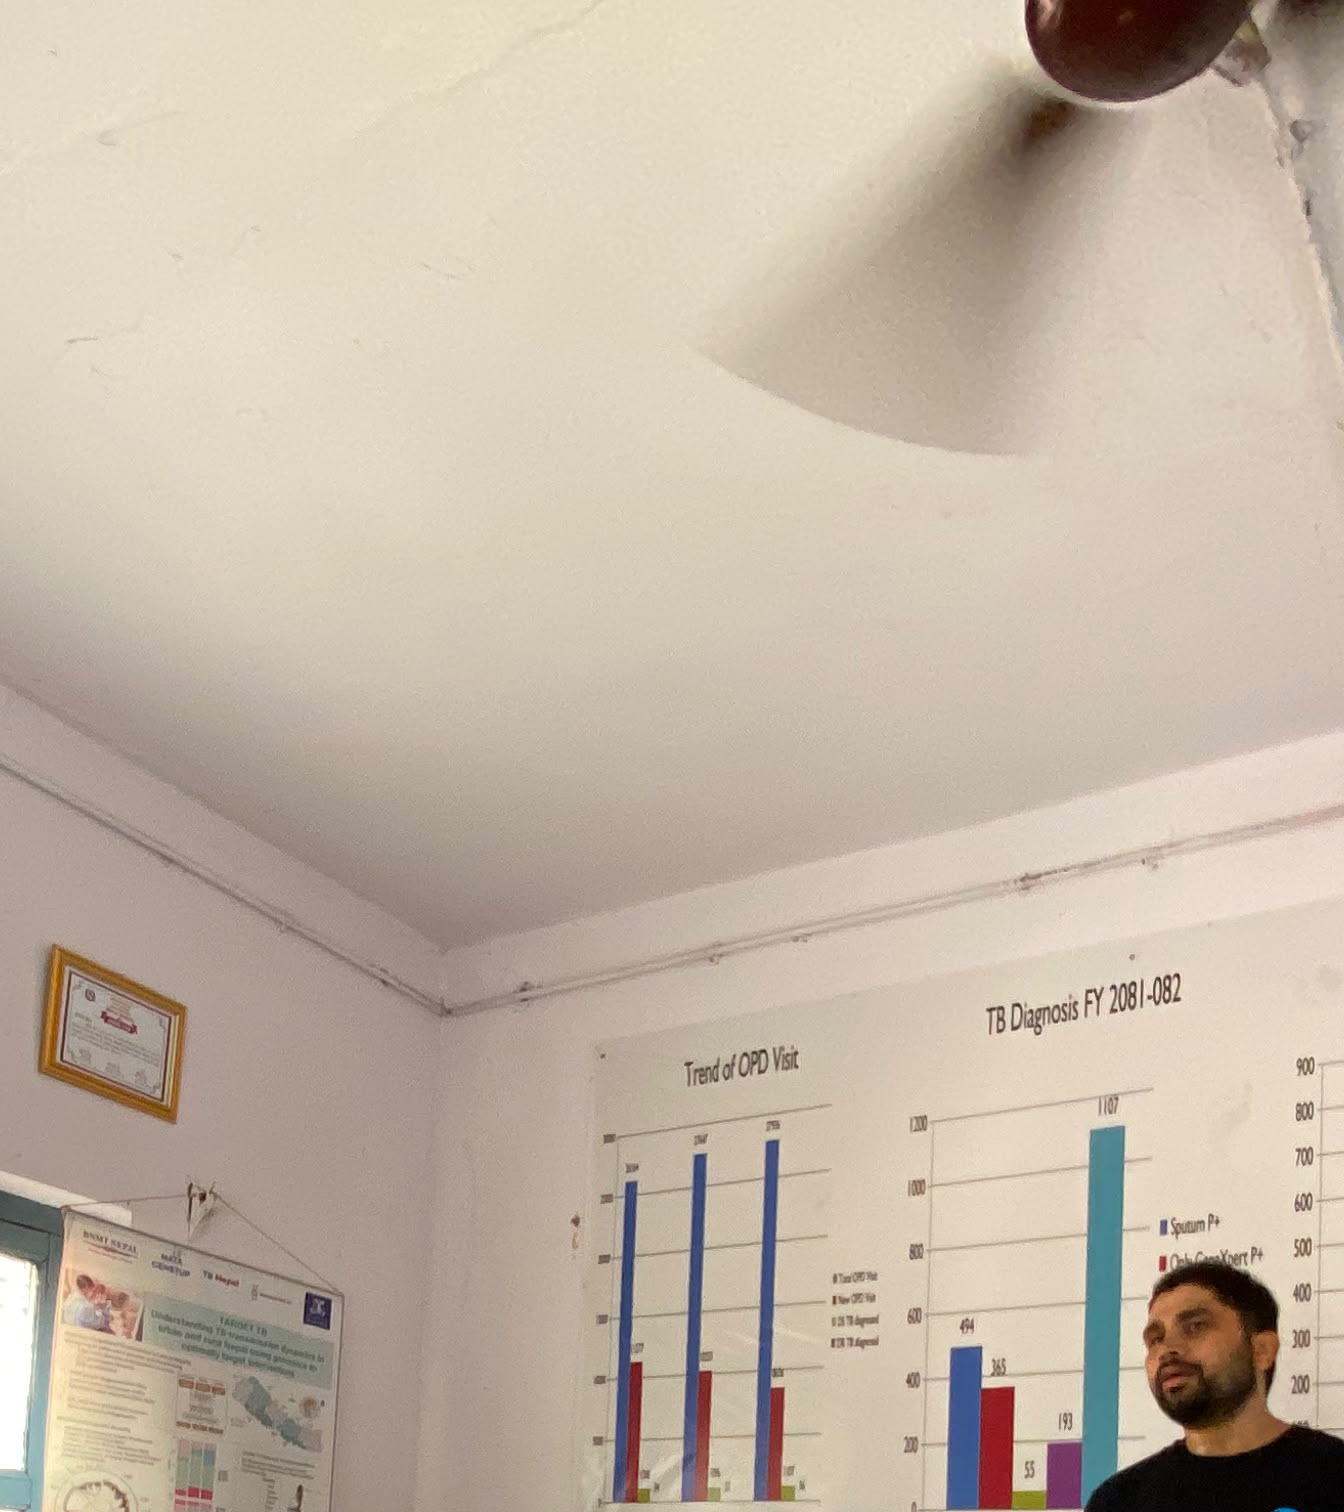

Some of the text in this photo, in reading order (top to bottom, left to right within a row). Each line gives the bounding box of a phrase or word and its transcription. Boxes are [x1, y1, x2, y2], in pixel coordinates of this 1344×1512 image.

[986, 972, 1183, 1036] TB Diagnosis FY 2081-082
[684, 1044, 800, 1087] Trend of OPD Visit
[1296, 1056, 1316, 1076] 900
[1097, 1096, 1120, 1117] 1107
[1295, 1102, 1315, 1122] 800
[909, 1115, 928, 1133] 1200
[1295, 1147, 1315, 1167] 700
[907, 1179, 927, 1197] 1000
[1294, 1192, 1313, 1213] 600
[1171, 1213, 1221, 1240] Sputum P+
[1293, 1237, 1313, 1258] 500
[1292, 1283, 1312, 1303] 400
[958, 1318, 976, 1335] 494
[1291, 1329, 1311, 1349] 300
[990, 1358, 1008, 1378] 365
[1290, 1374, 1311, 1395] 200
[1057, 1411, 1074, 1432] 193
[1023, 1459, 1036, 1480] 55
